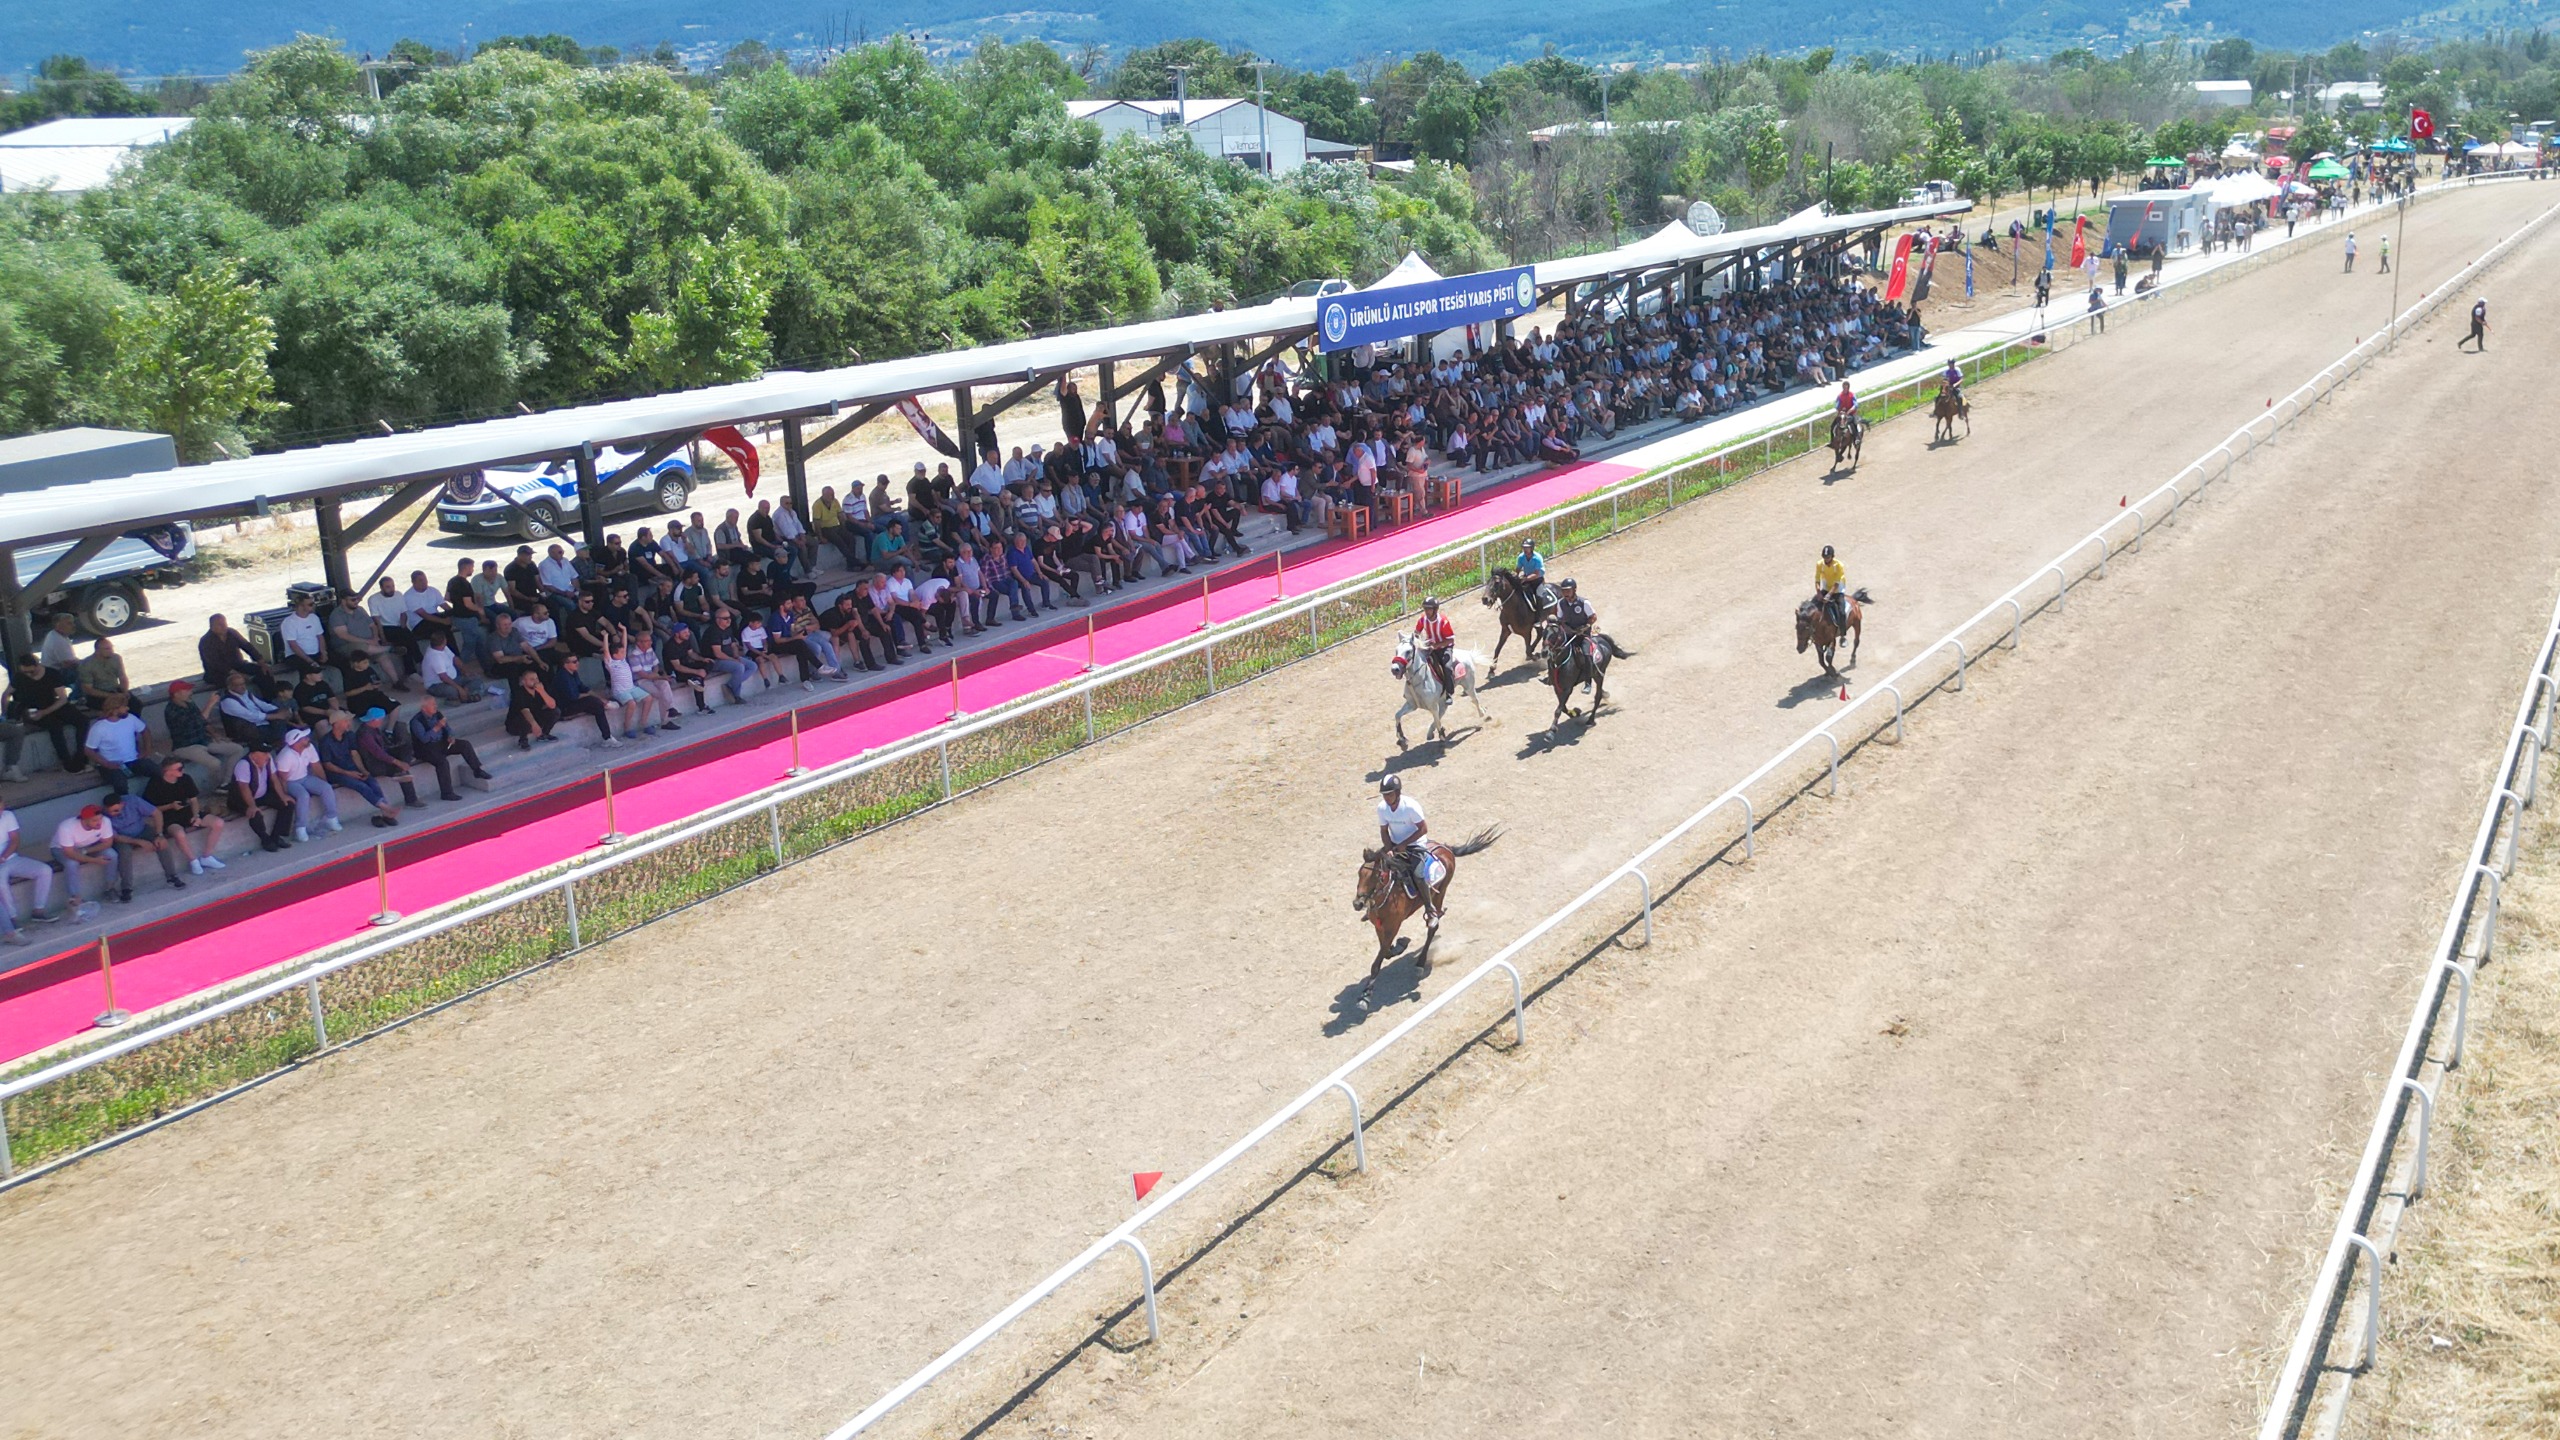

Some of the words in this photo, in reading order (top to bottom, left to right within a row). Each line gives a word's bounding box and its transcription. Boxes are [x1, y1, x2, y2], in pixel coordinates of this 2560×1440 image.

[1350, 302, 1390, 328] ÜRÜNLÜ
[1392, 302, 1413, 321] ATLI
[1414, 298, 1438, 317] SPOR
[1439, 289, 1467, 312] TESİSİ
[1468, 289, 1493, 307] YARIŞ
[1493, 281, 1514, 302] PİSTİ
